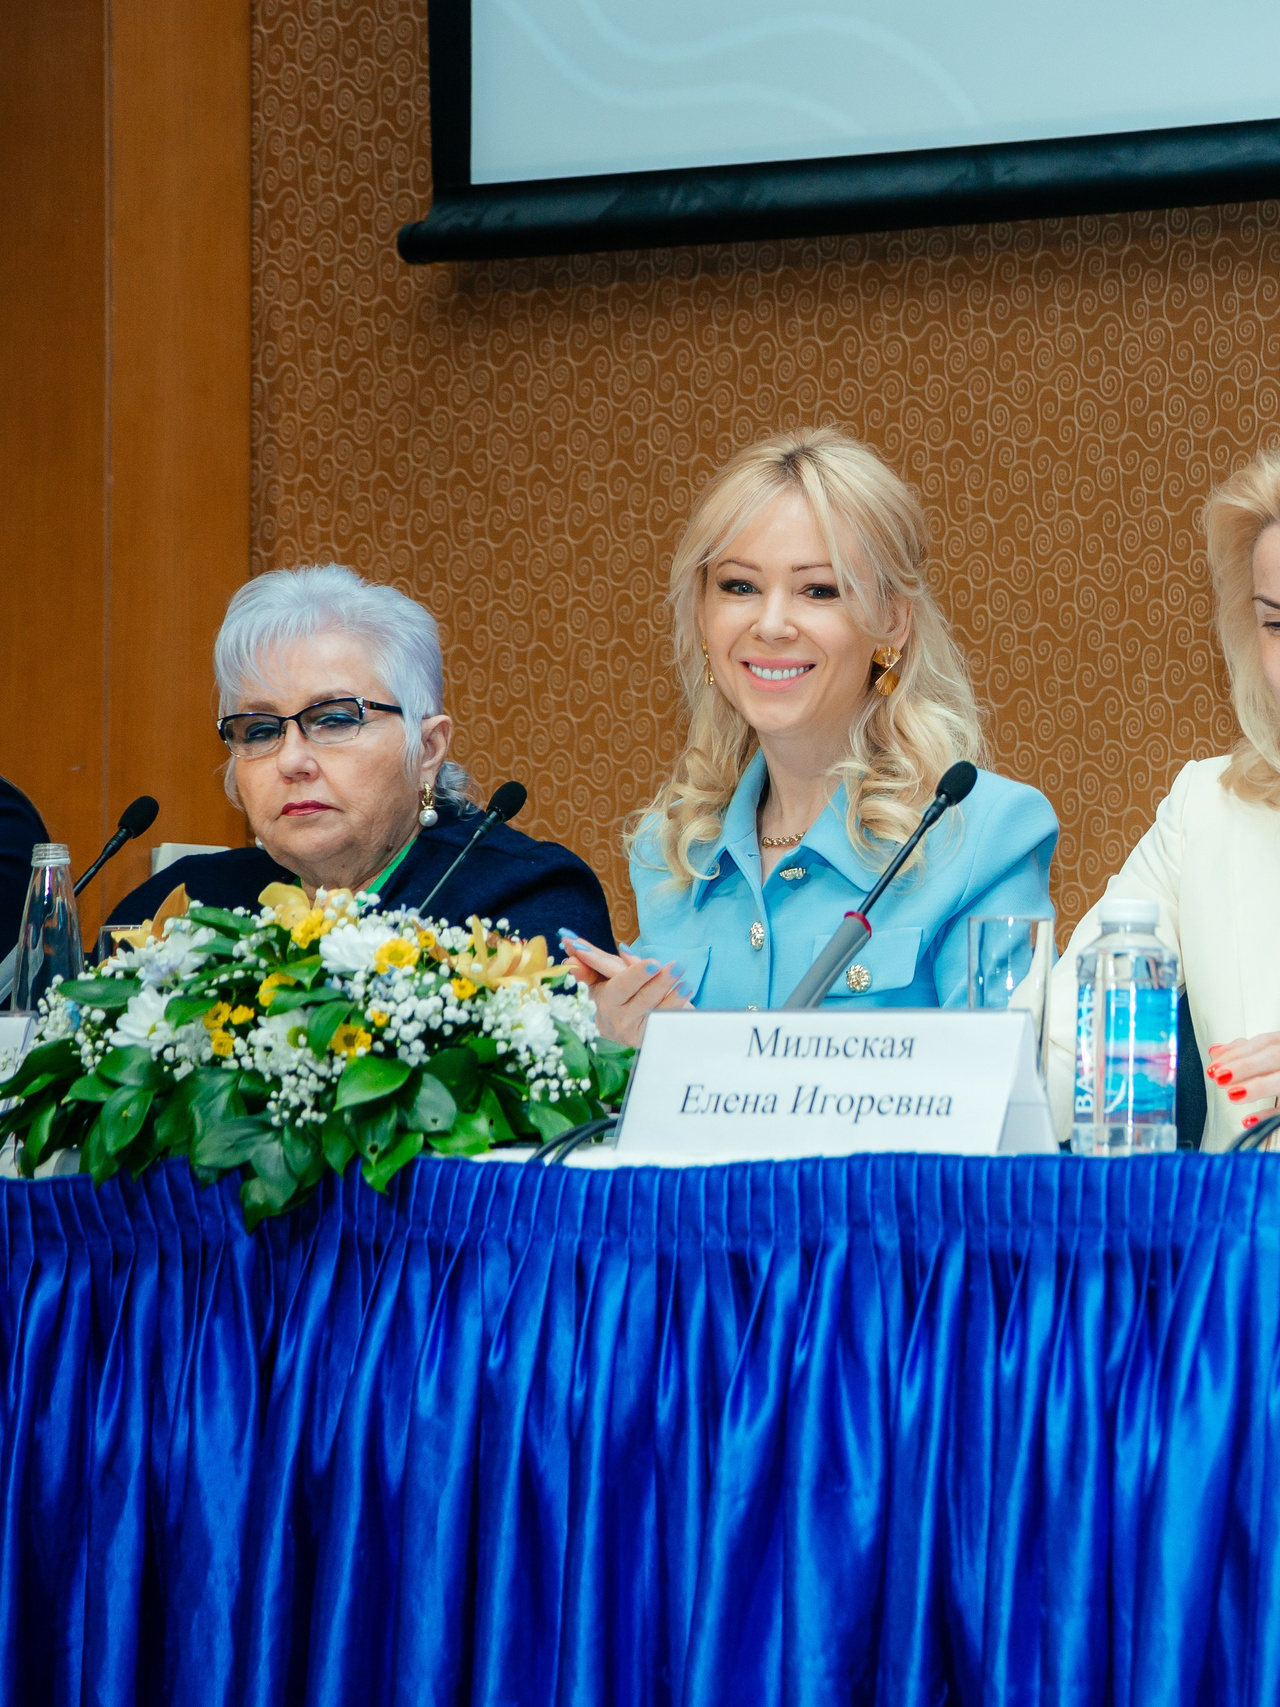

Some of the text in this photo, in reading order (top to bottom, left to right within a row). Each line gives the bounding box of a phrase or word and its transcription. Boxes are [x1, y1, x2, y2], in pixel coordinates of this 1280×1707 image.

[747, 1026, 916, 1059] Мильская
[678, 1084, 952, 1124] Елена Игоревна
